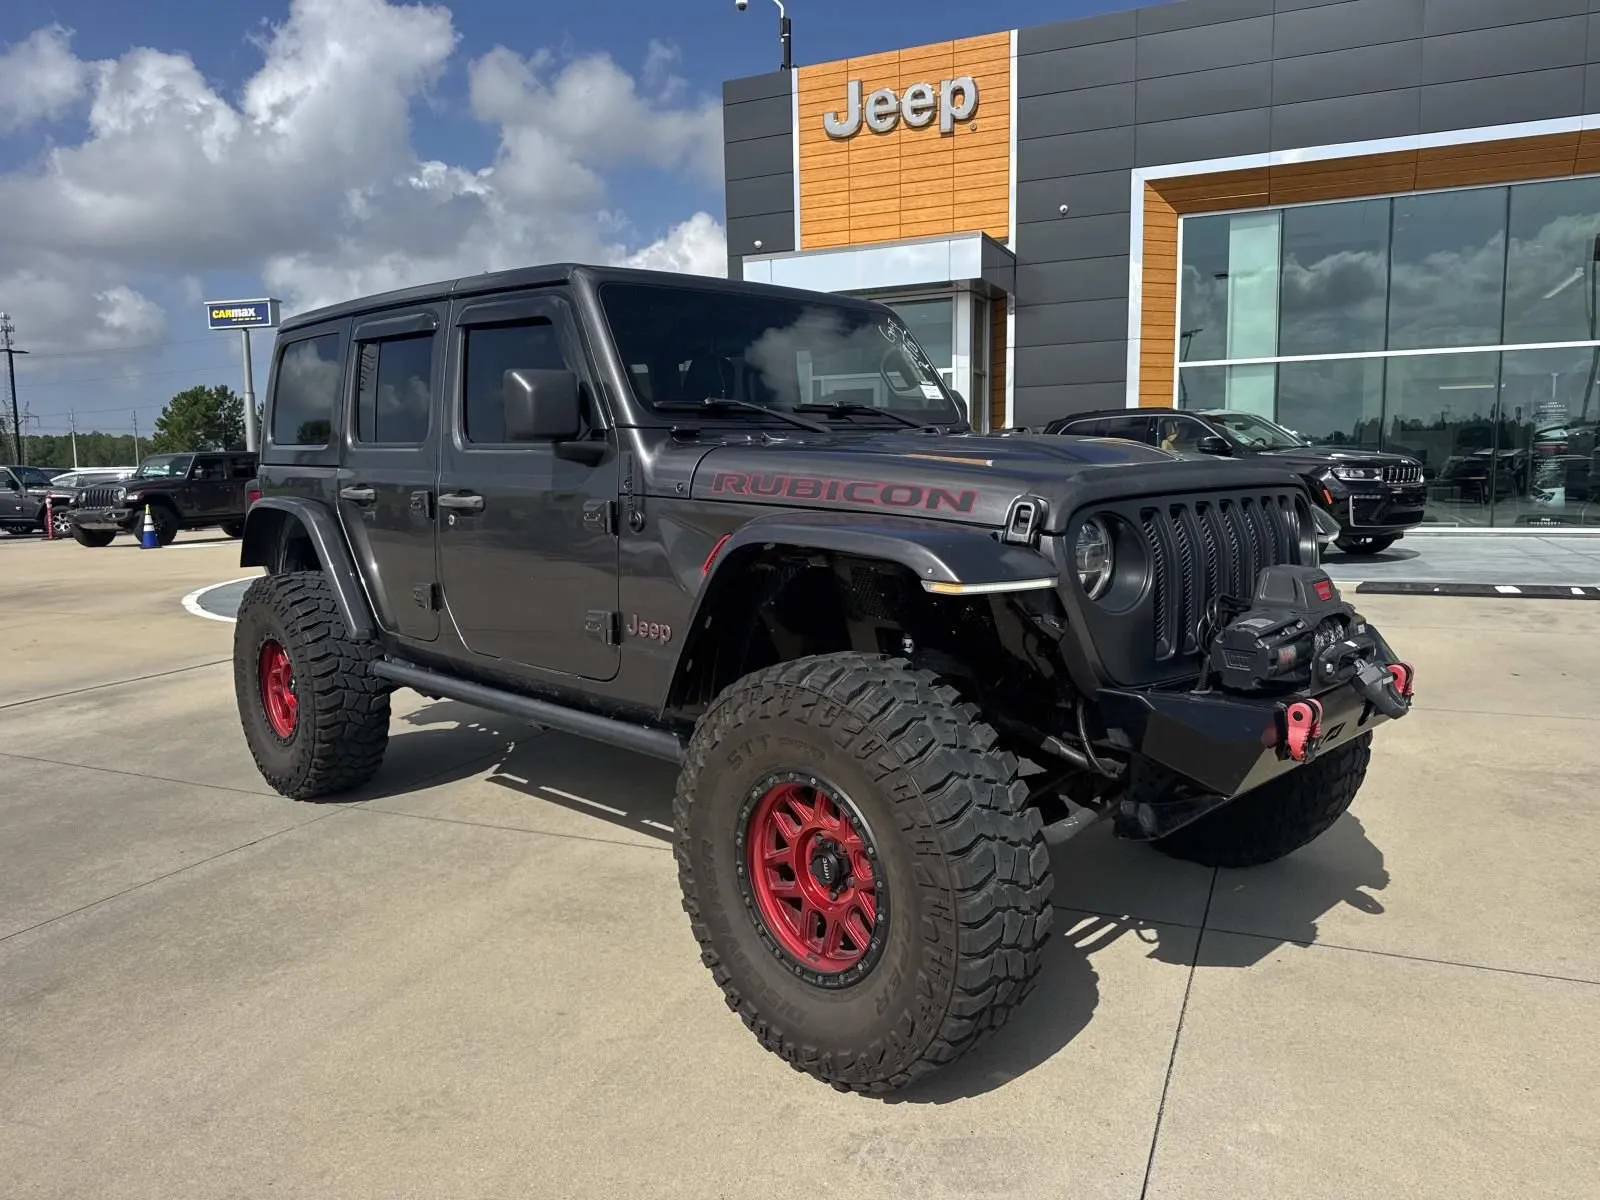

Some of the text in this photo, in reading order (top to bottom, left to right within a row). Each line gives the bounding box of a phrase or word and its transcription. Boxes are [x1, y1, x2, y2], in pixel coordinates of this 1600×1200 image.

[824, 76, 979, 140] Jeep
[711, 471, 979, 514] RUBICON
[626, 614, 672, 645] Jeep
[727, 733, 771, 774] STT
